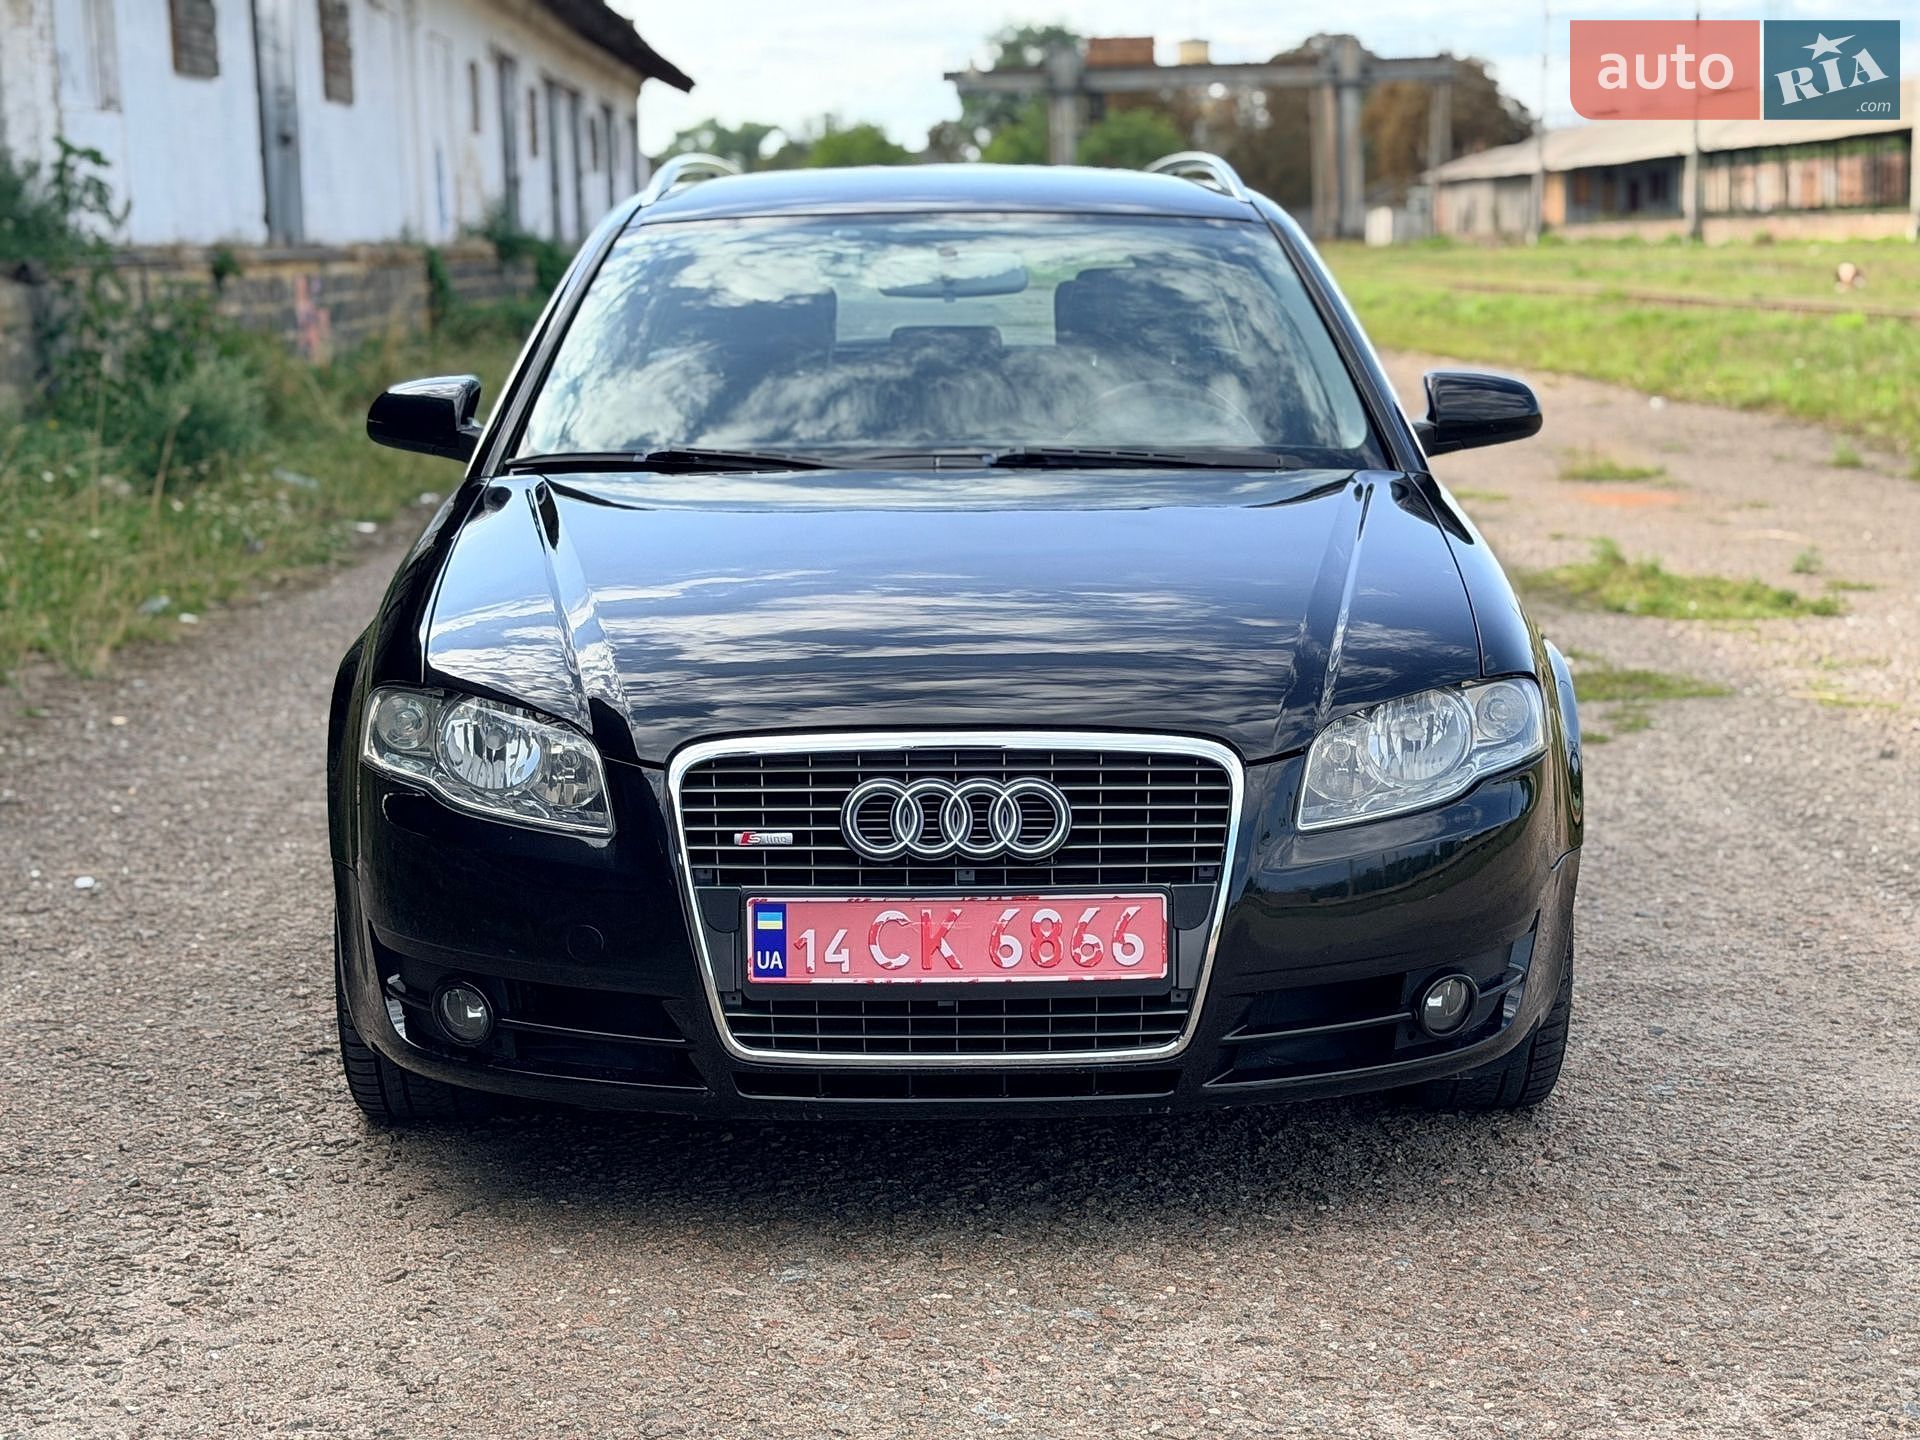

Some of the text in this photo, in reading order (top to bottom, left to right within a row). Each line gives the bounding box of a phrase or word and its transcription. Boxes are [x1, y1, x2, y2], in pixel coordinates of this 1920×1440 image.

[757, 951, 783, 970] UA
[793, 905, 1145, 974] 14 CK 6866
